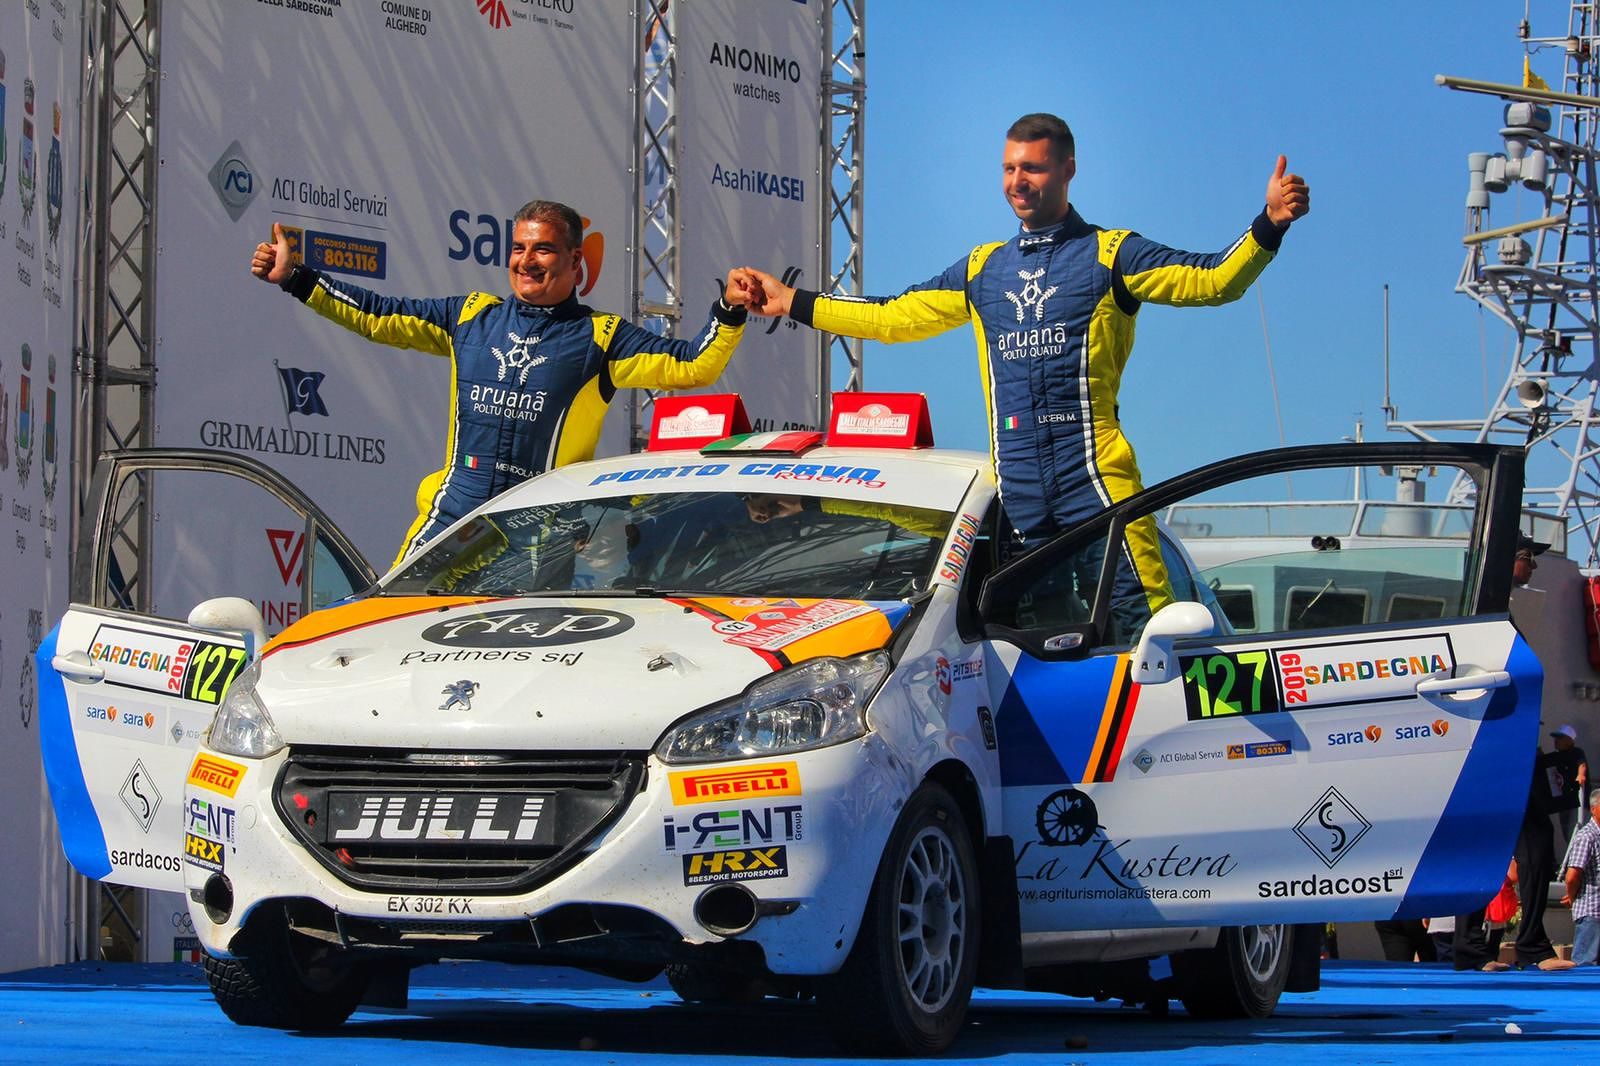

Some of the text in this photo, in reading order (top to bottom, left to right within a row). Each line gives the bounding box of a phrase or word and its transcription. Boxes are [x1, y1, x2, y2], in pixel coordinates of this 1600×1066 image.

[286, 0, 333, 17] SARDEGNA
[381, 1, 431, 22] COMUNE DI
[385, 18, 428, 36] ALGHERO
[709, 42, 801, 83] ANONIMO
[733, 82, 781, 104] watches
[712, 163, 804, 202] AsahiKASEI
[272, 178, 388, 217] ACI Global Servizi
[998, 322, 1066, 351] aruanã
[1002, 344, 1062, 361] POLTU QUATU
[470, 384, 547, 412] aruanã
[473, 403, 538, 422] POLTU QUATU
[200, 420, 386, 465] GRIMALDI LINES
[588, 463, 881, 486] PORTO CERVO
[773, 472, 887, 489] Racing
[940, 512, 981, 584] SARDEGNA
[721, 621, 749, 632] 127
[91, 642, 170, 673] SARDEGNA
[168, 644, 192, 692] 2019
[399, 650, 531, 666] Partners
[1304, 654, 1448, 685] SARDEGNA
[191, 644, 247, 703] 127
[1185, 650, 1269, 718] 127
[1279, 653, 1308, 705] 2019
[86, 706, 144, 727] sara sara
[1327, 721, 1432, 746] sara sara
[1160, 753, 1173, 763] ACI
[1174, 751, 1198, 762] Global
[1198, 750, 1224, 760] Servizi
[191, 758, 239, 790] PIRELLI
[682, 768, 790, 798] PIRELLI
[335, 797, 545, 840] JULLI
[794, 812, 803, 841] Group
[111, 848, 183, 872] sardacos
[185, 834, 223, 863] HRX
[689, 848, 781, 876] HRX
[731, 868, 785, 880] MOTORSPORT
[1080, 839, 1239, 890] Kustera
[1258, 866, 1404, 898] sardacost srl
[388, 897, 473, 915] EX 302 KX
